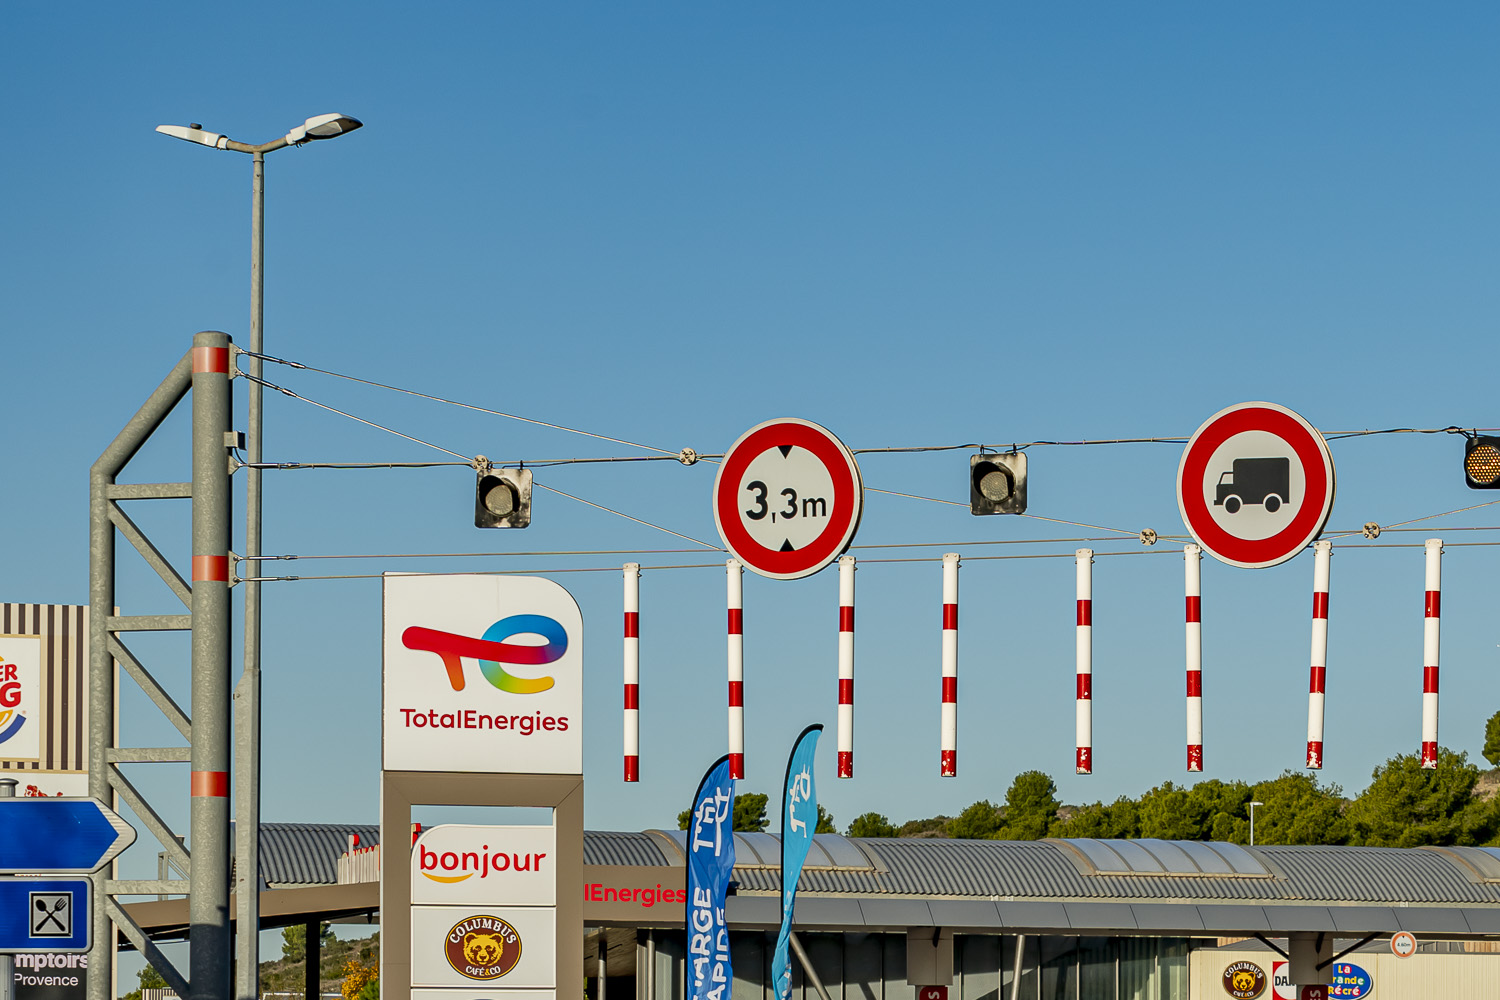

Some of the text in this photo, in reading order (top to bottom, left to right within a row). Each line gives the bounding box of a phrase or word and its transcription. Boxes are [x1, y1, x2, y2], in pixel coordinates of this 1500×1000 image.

[745, 480, 827, 524] 3,3m
[400, 708, 569, 736] TotalEnergies
[420, 843, 547, 878] bonjour
[584, 883, 686, 908] lEnergies
[449, 917, 517, 945] COLUMBUS
[15, 953, 87, 972] mptoirs
[1224, 962, 1263, 980] COLUMBUS
[1338, 964, 1351, 974] La
[1333, 976, 1364, 985] rande
